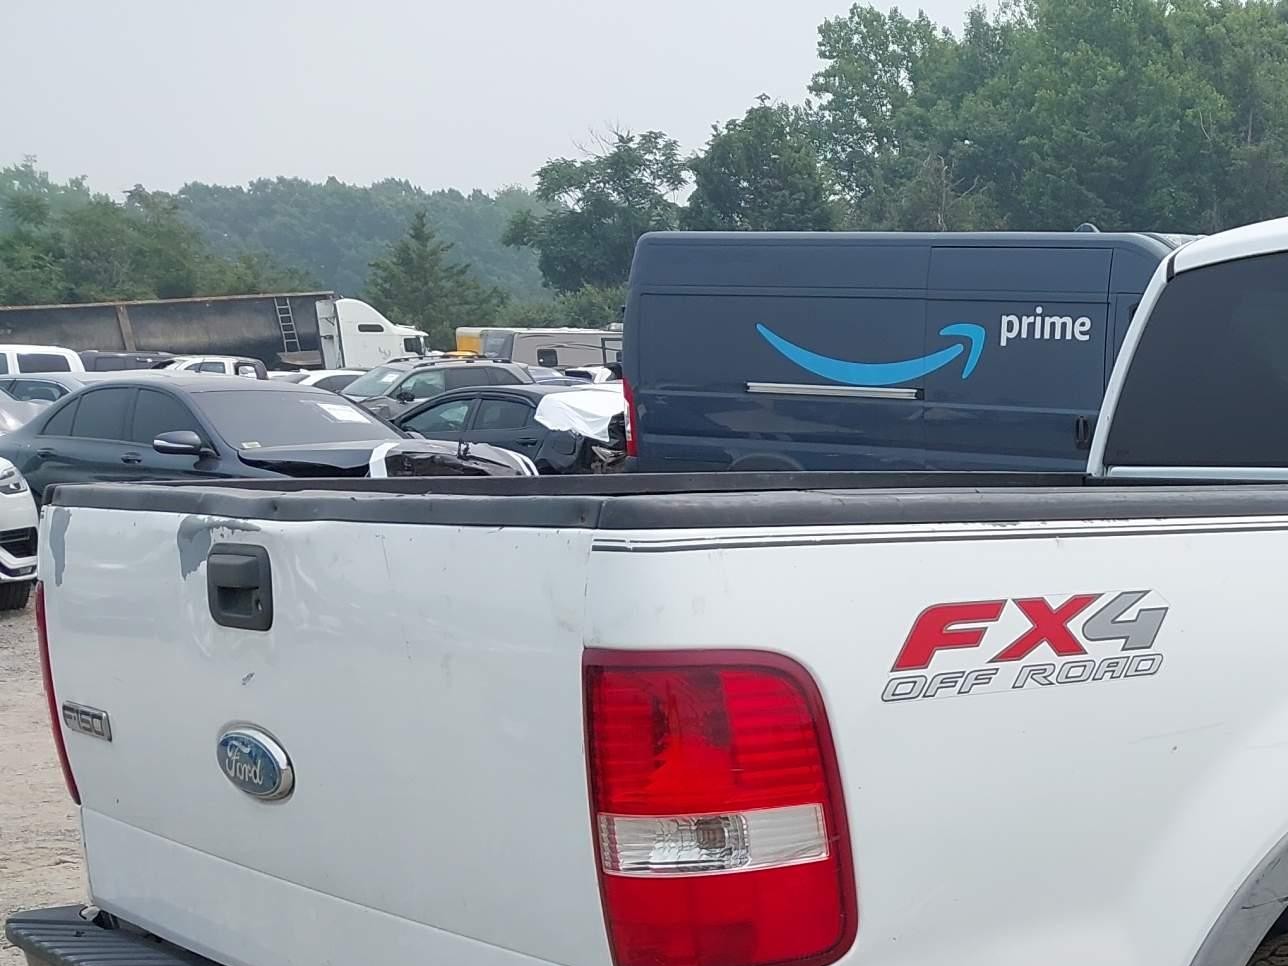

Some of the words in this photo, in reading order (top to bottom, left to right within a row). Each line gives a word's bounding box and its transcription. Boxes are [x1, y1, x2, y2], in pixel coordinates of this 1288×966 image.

[1000, 306, 1092, 346] prime
[889, 589, 1168, 672] FX4
[881, 667, 999, 702] OFF
[1012, 653, 1164, 689] ROAD
[226, 740, 264, 785] Ford
